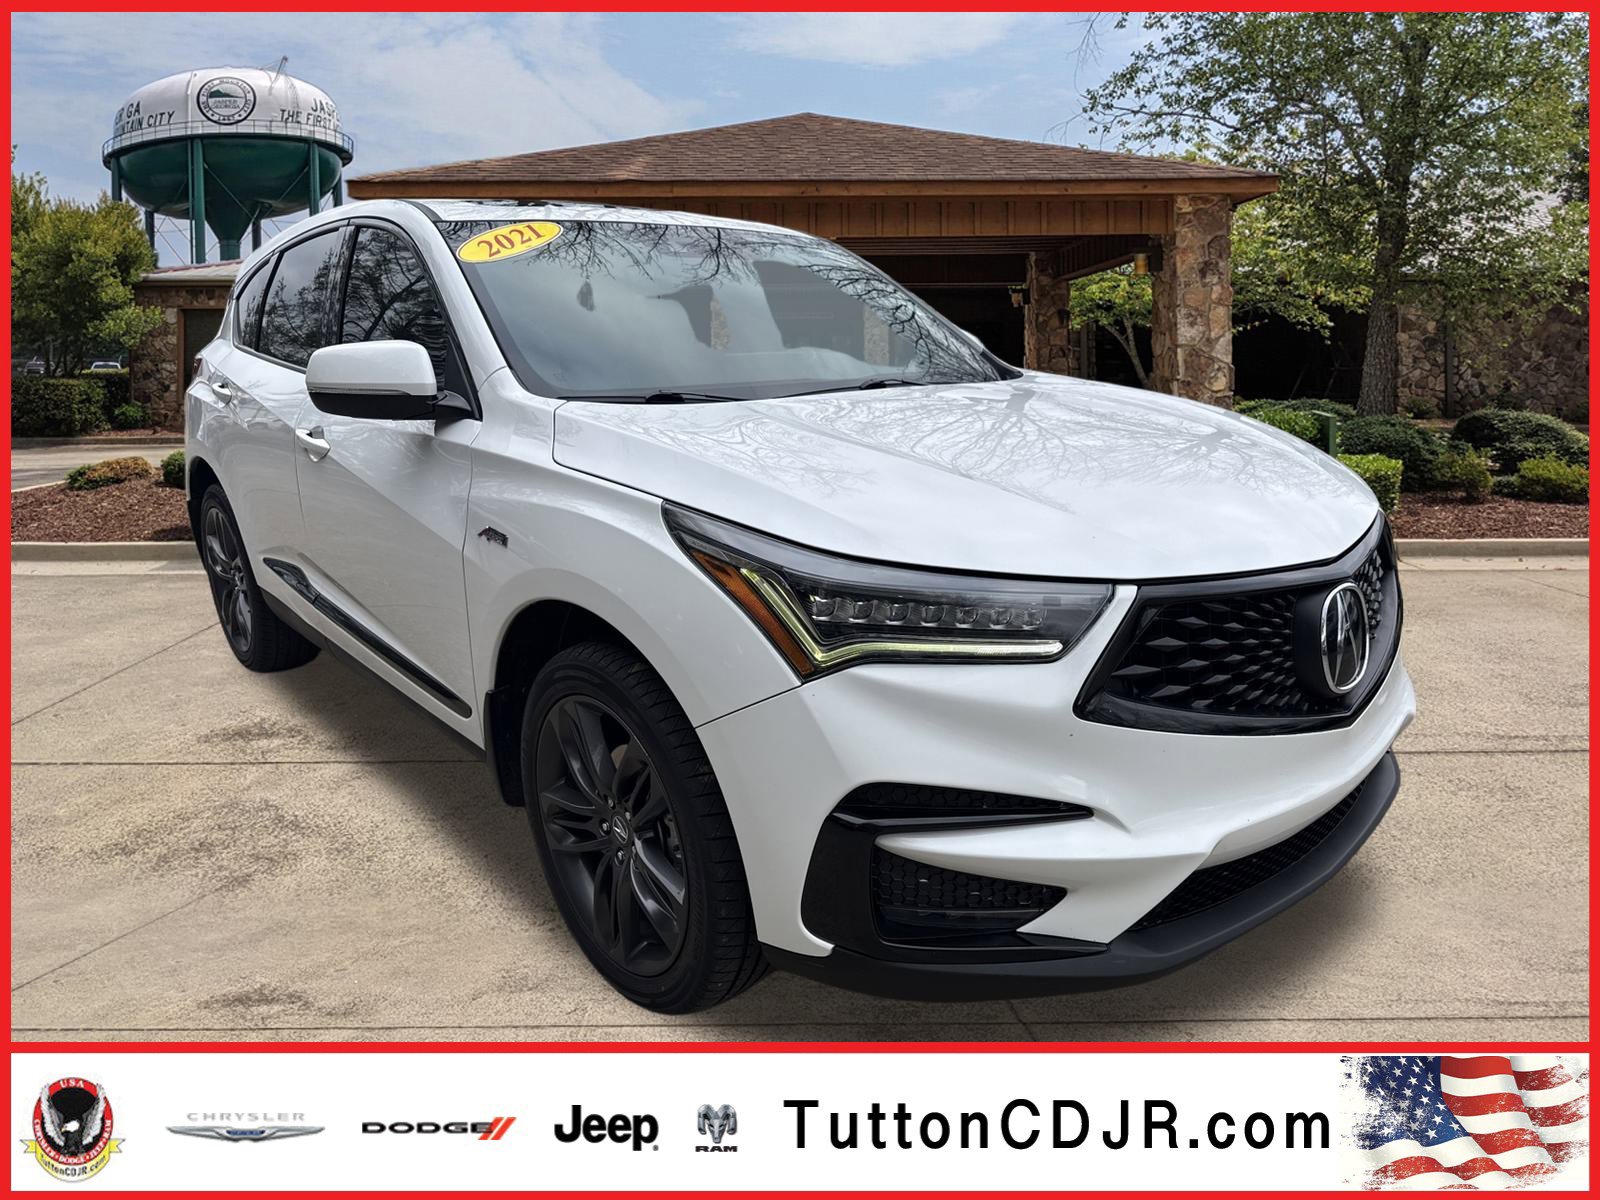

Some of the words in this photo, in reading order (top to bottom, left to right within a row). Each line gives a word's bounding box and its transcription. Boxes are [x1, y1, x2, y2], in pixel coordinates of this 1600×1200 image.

[126, 100, 141, 119] GA
[147, 110, 175, 127] CITY
[280, 109, 302, 124] THE
[477, 224, 545, 258] 2021
